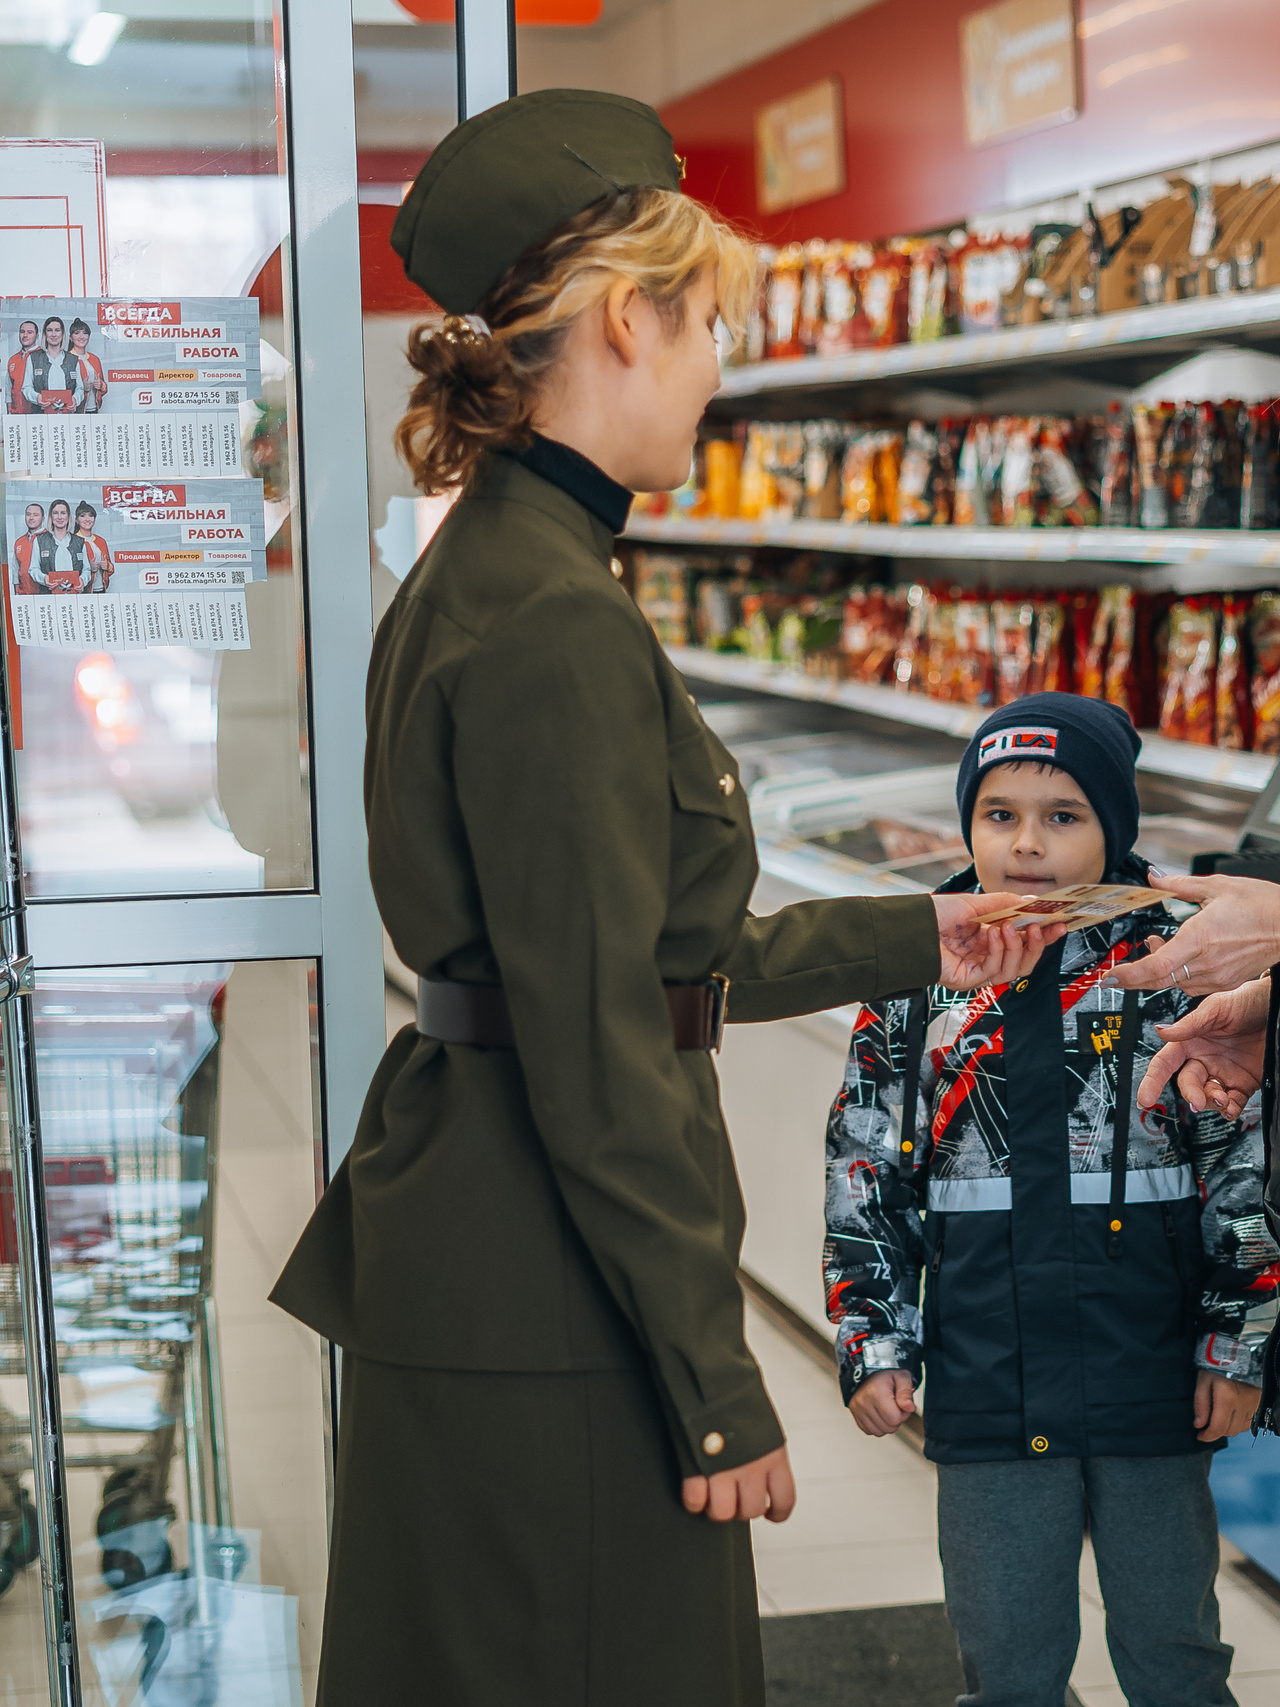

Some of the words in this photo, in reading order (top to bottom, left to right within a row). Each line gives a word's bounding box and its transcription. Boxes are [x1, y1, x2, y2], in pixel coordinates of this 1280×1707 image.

[105, 307, 172, 322] ВСЕГДА
[124, 328, 221, 338] СТАБИЛЬНАЯ
[183, 347, 239, 358] РАБОТА
[112, 372, 149, 380] Продавец
[159, 372, 194, 380] Директор
[203, 371, 242, 379] Товаровед
[110, 490, 177, 504] ВСЕГДА
[130, 510, 226, 520] СТАБИЛЬНАЯ
[188, 529, 244, 539] РАБОТА
[165, 553, 200, 561] Директор
[208, 552, 247, 560] Товаровед
[981, 734, 1052, 758] FILA
[872, 1263, 891, 1280] 72
